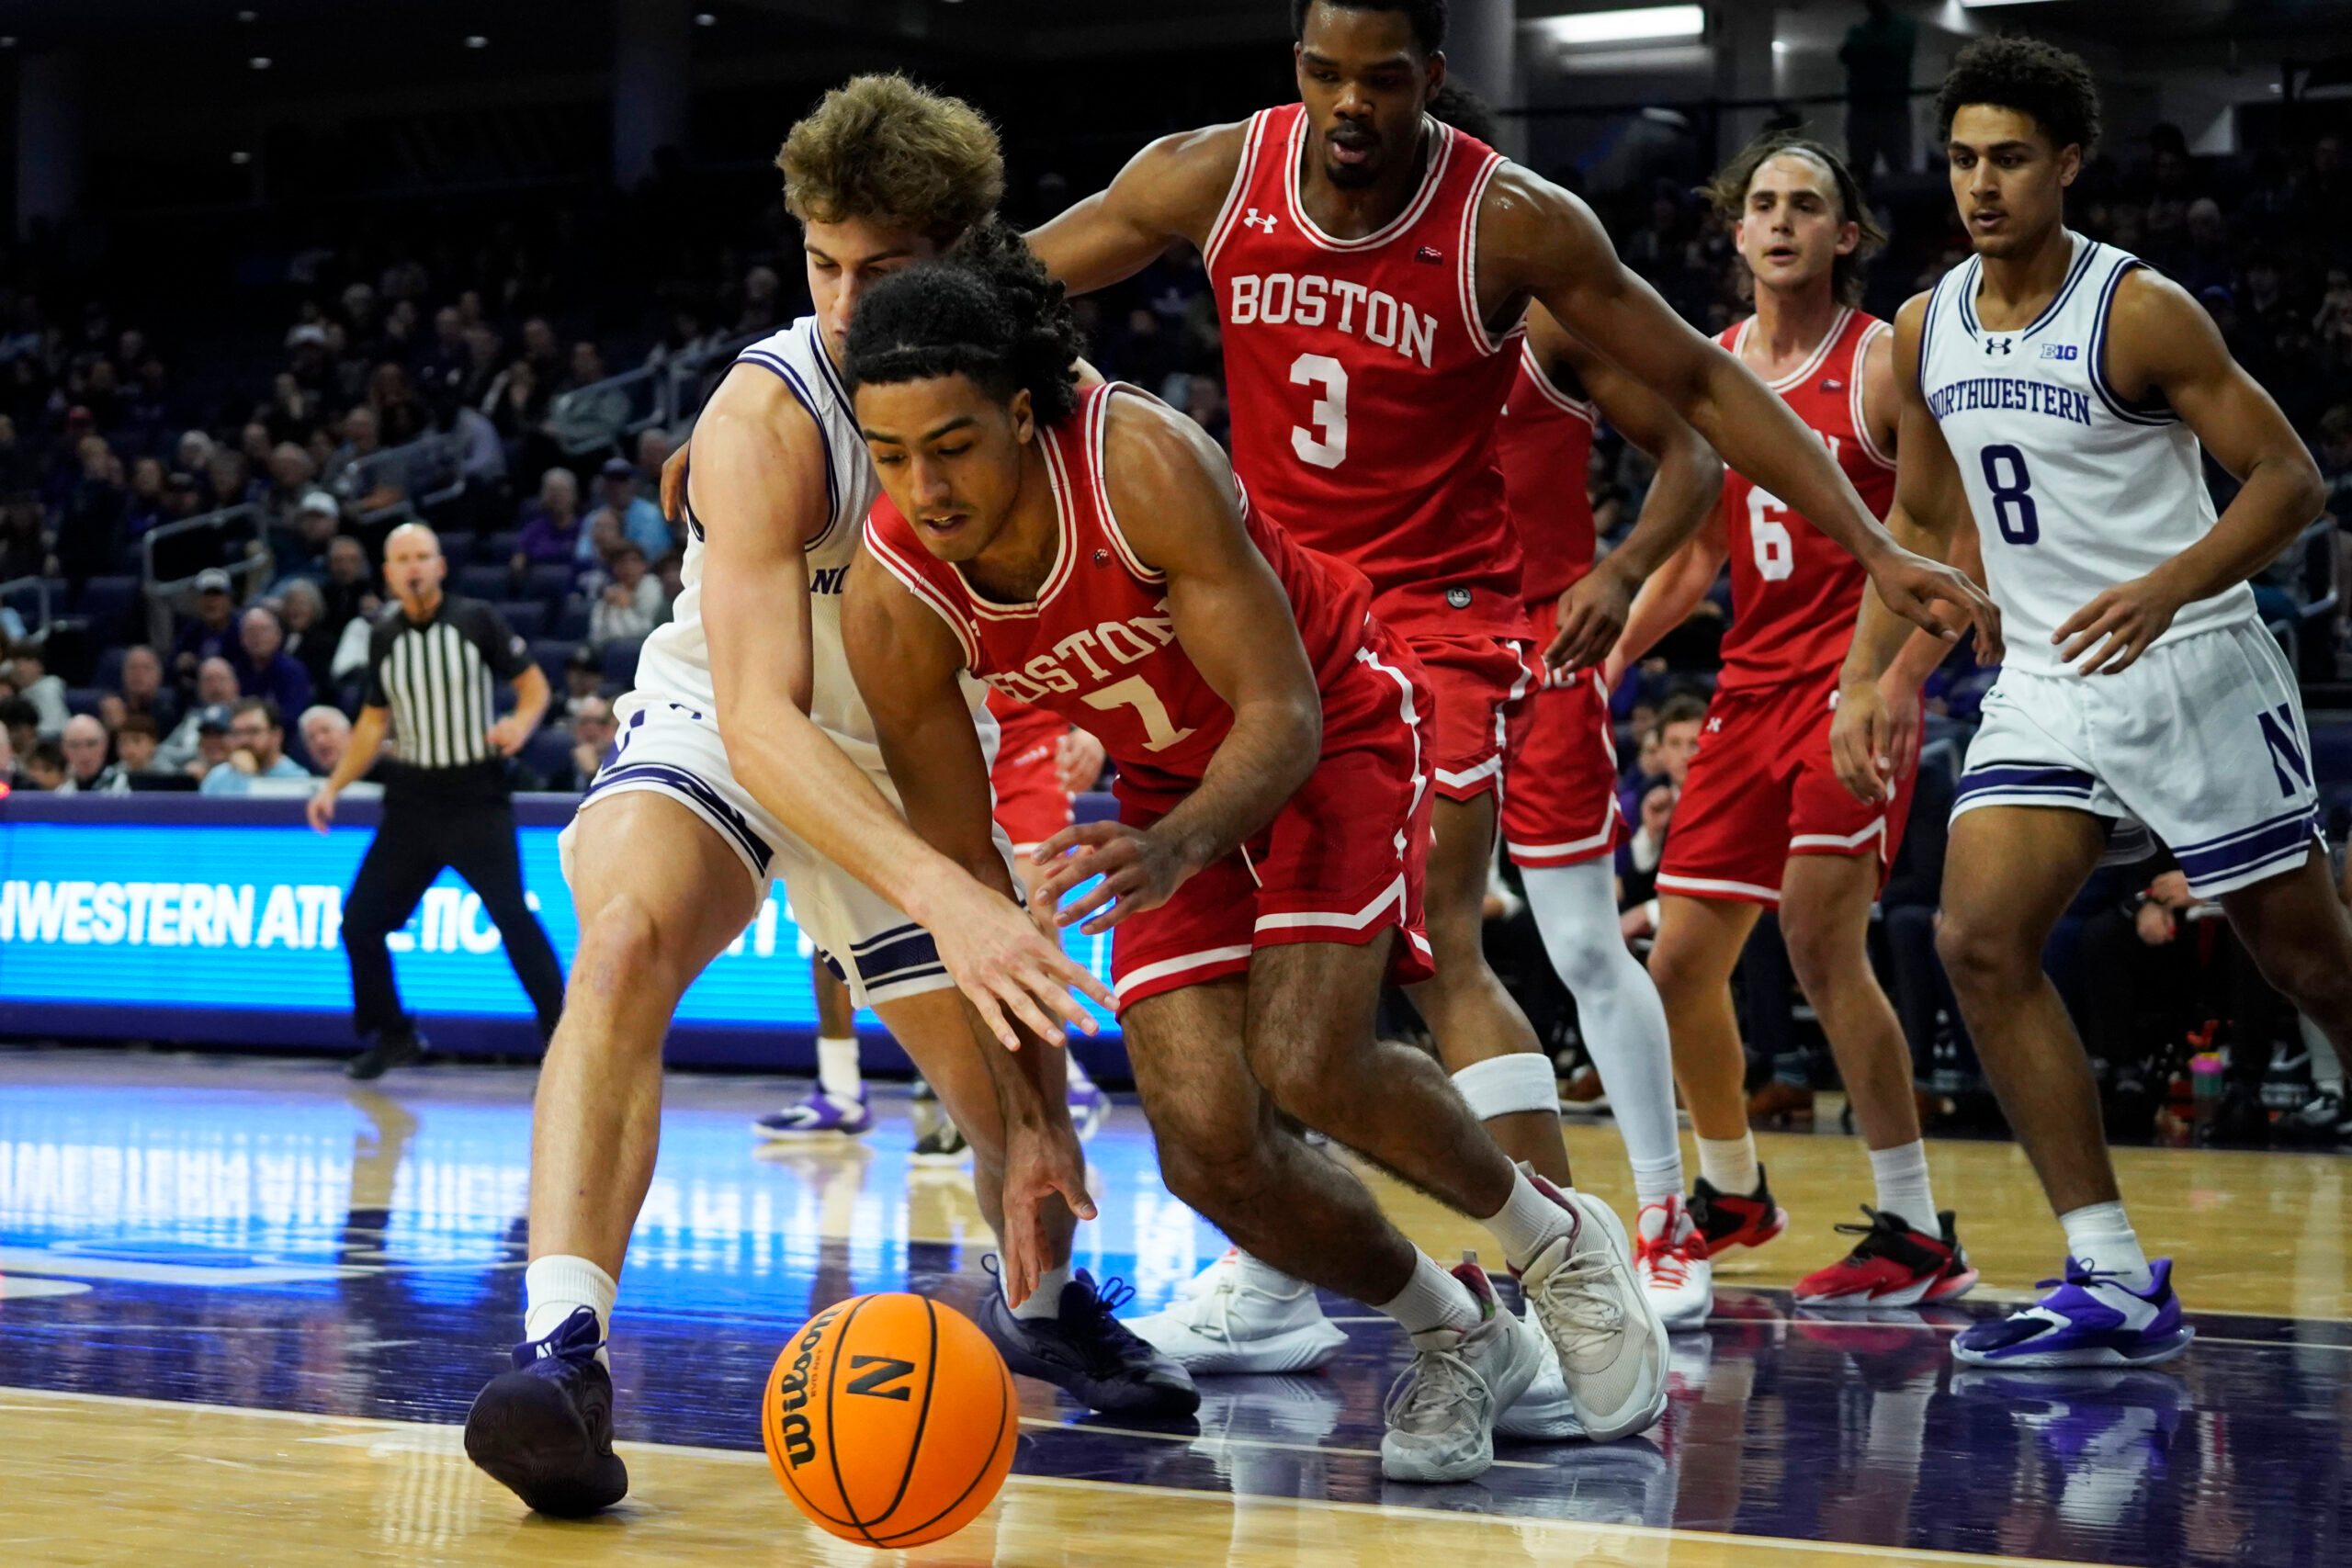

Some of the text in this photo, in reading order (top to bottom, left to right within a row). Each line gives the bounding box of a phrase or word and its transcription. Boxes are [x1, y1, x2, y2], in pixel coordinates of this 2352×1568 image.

[1231, 273, 1438, 368] BOSTON
[1289, 353, 1349, 469] 3
[1928, 378, 2091, 426] NORTHWESTERN
[1747, 485, 1794, 581] 6
[1980, 445, 2040, 545] 8
[1080, 674, 1197, 753] 7
[2256, 702, 2312, 799] N
[781, 1308, 842, 1470] Wilson
[846, 1355, 916, 1402] N
